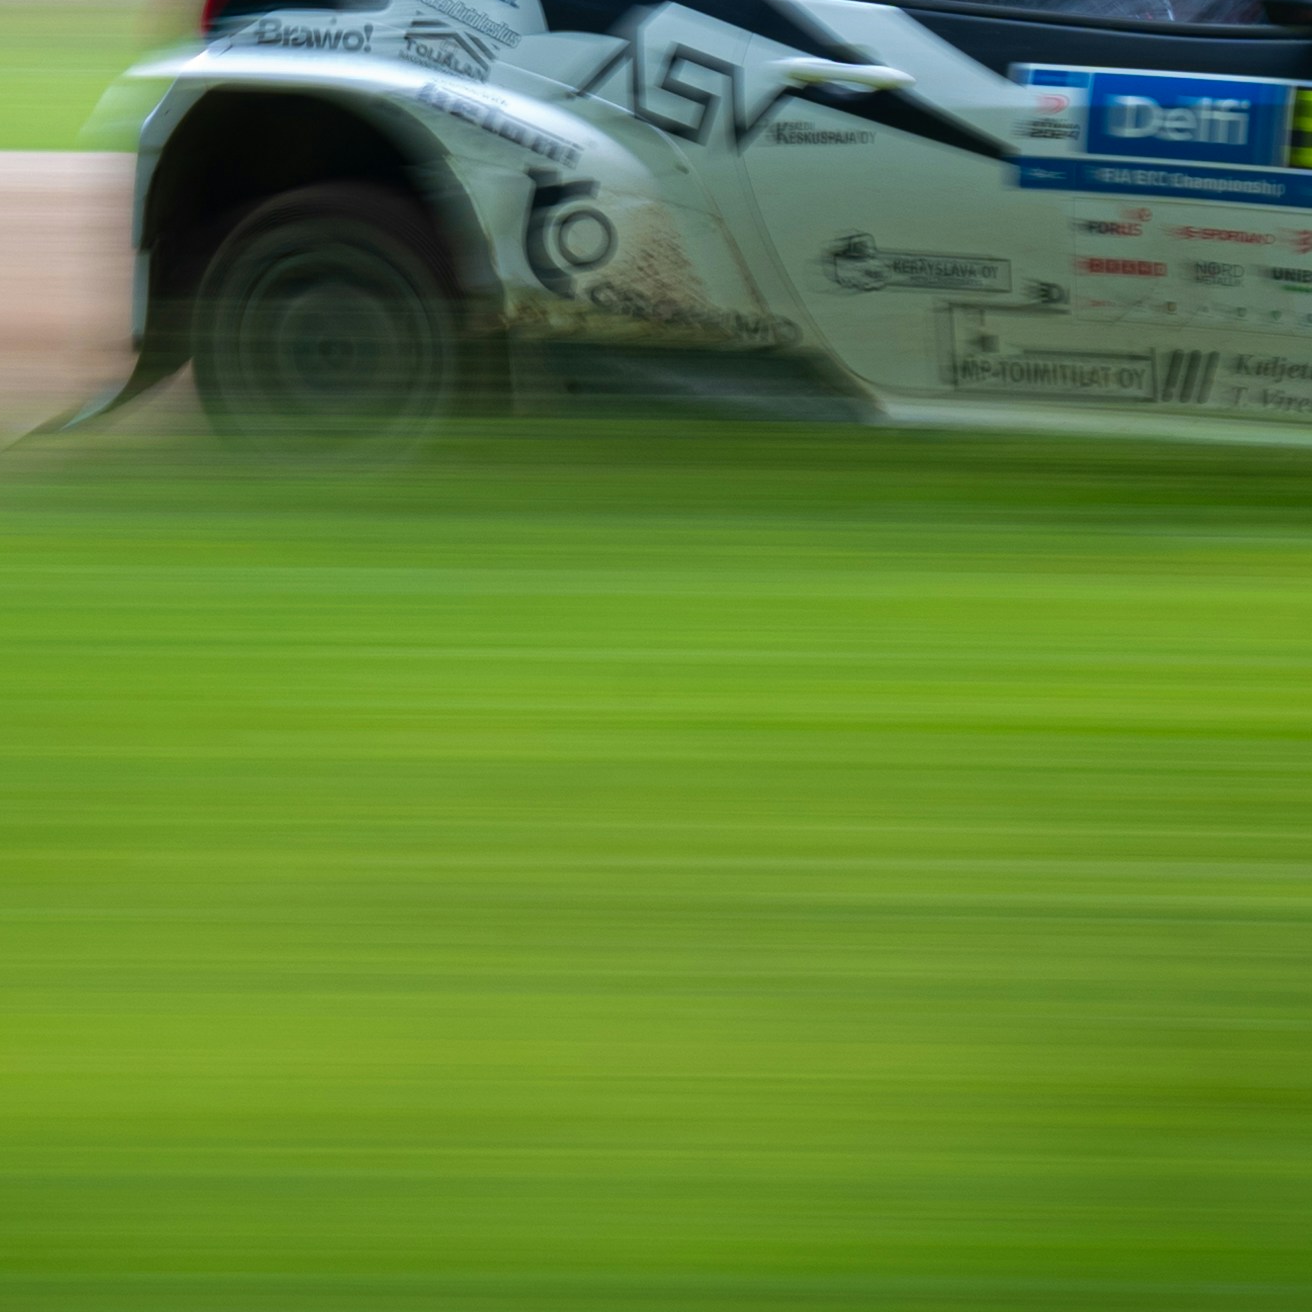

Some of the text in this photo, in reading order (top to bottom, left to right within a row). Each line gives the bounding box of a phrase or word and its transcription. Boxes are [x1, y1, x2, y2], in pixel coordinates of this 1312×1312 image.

[255, 17, 374, 53] Brawo!
[1107, 94, 1250, 145] Delfi
[1103, 168, 1132, 185] FIA
[1173, 172, 1286, 197] Championship
[1119, 366, 1146, 389] OY
